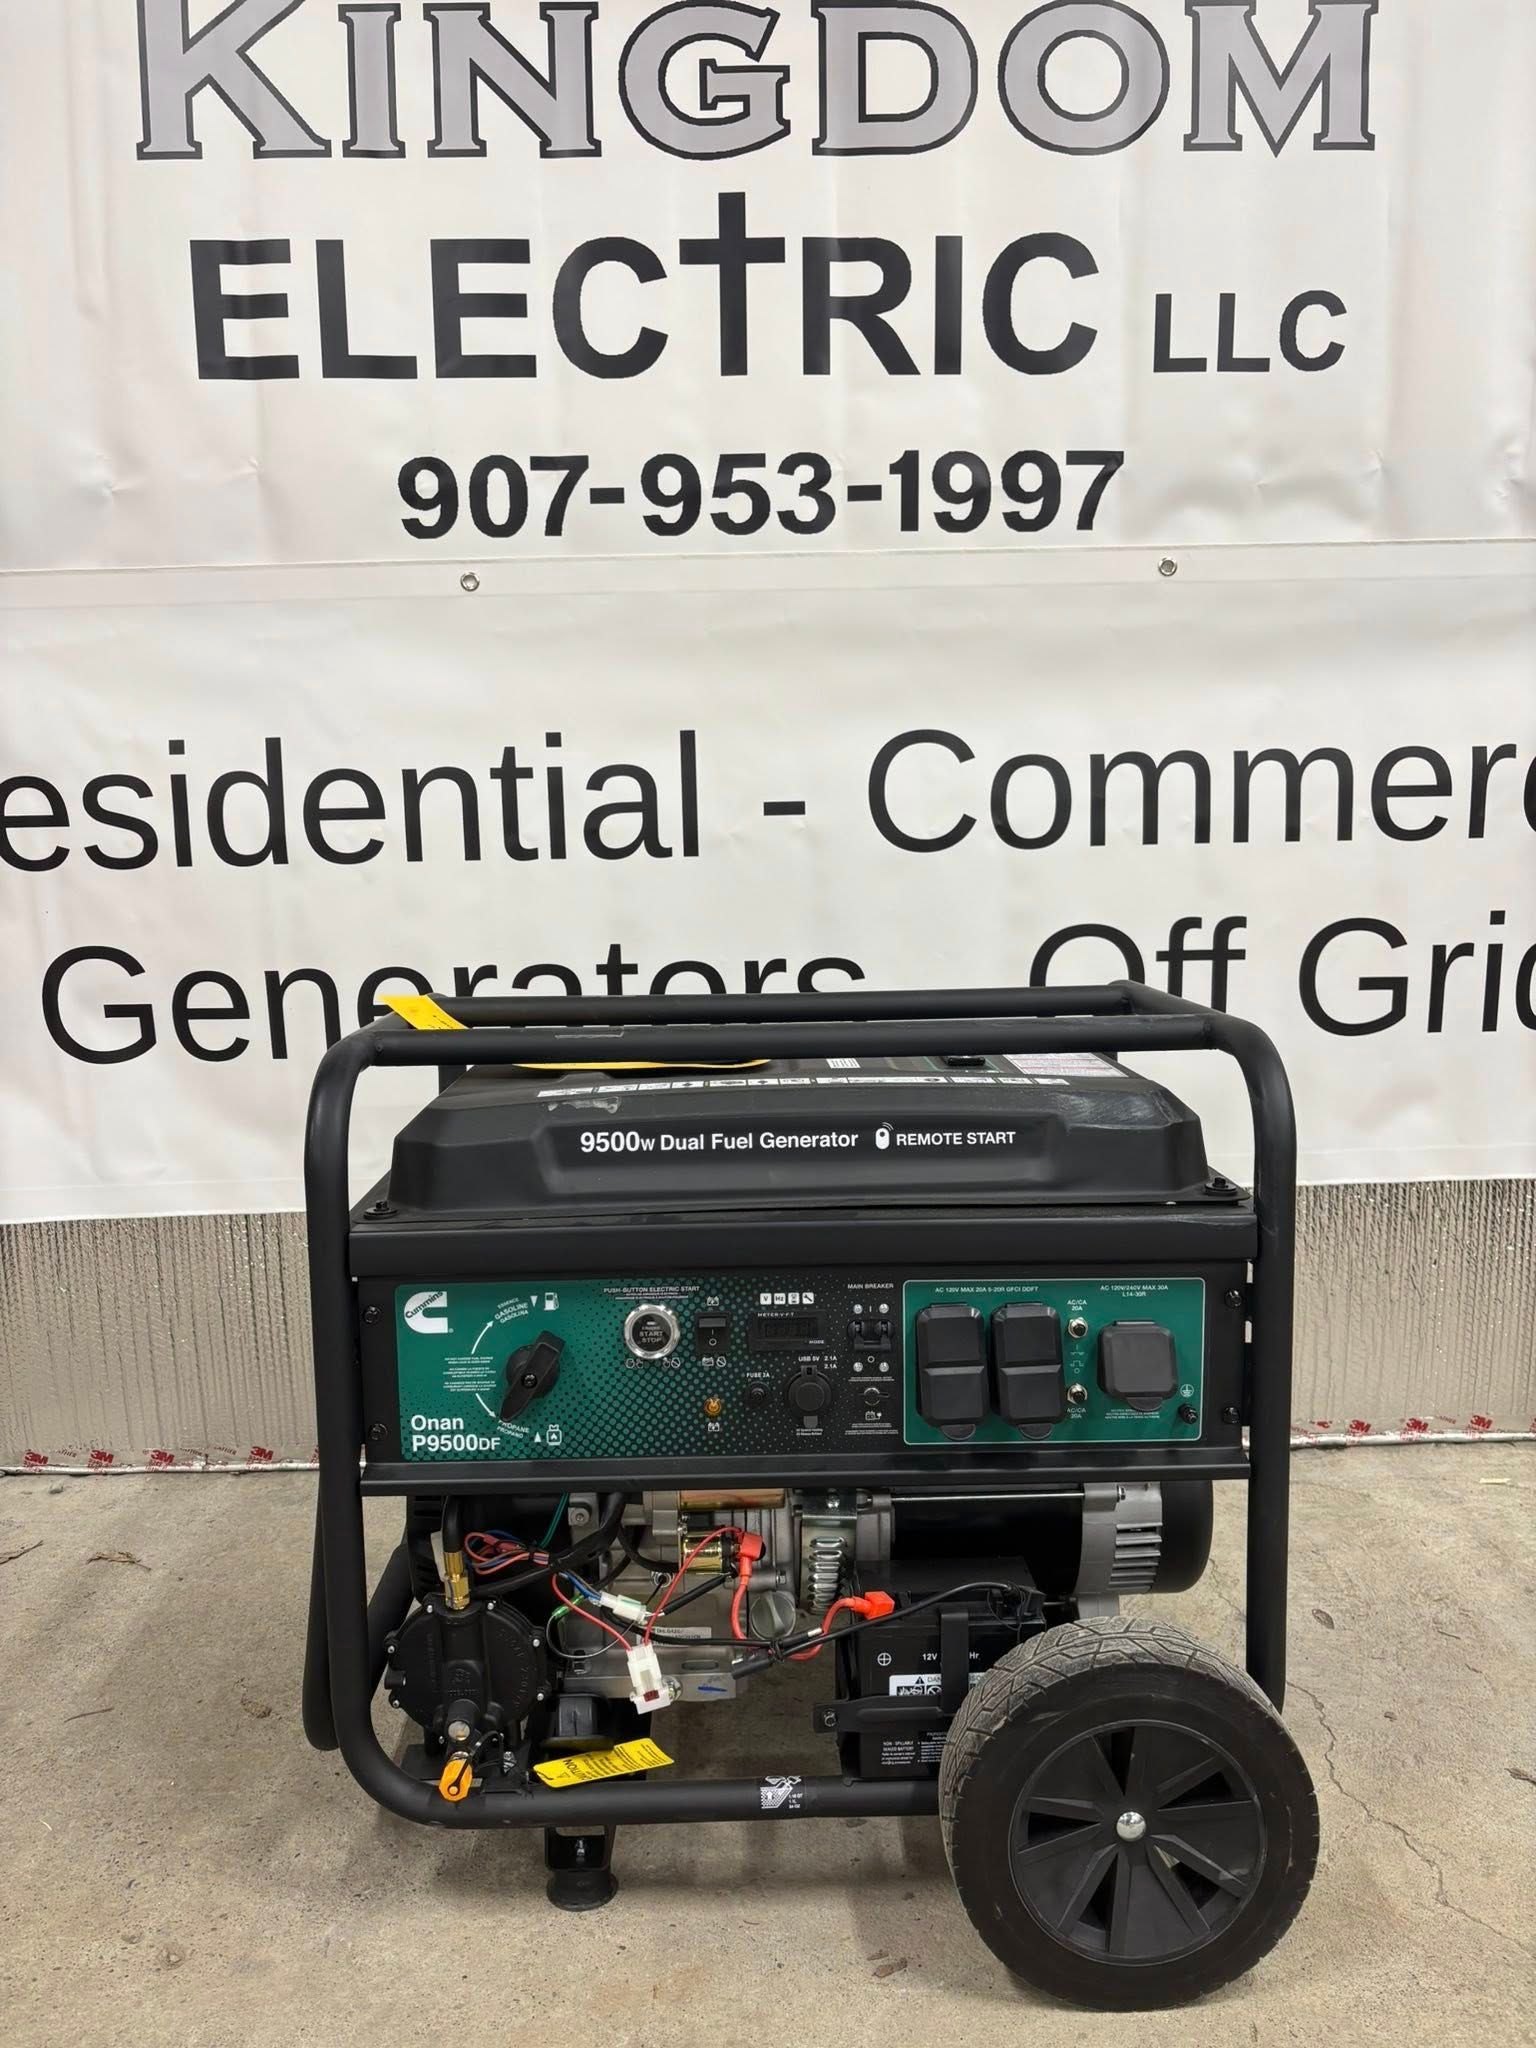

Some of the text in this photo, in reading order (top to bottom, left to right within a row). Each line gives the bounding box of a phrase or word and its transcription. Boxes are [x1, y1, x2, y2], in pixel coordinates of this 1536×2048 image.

[136, 0, 1378, 160] KINGDOM
[190, 192, 1347, 380] ELECTRIC LLC
[397, 450, 1125, 540] 907-953-1997
[868, 728, 1536, 854] Commer
[1029, 915, 1248, 1014] Off
[1298, 909, 1536, 1038] Gri
[660, 1134, 705, 1150] Dual
[711, 1133, 753, 1150] Fuel
[759, 1132, 859, 1149] Generator
[896, 1132, 1016, 1146] REMOTE START
[405, 1291, 444, 1319] Cummins
[494, 1302, 528, 1320] GASOLINE
[500, 1309, 528, 1324] GASOLINA
[410, 1414, 464, 1430] Onan
[498, 1420, 530, 1434] PROPANE
[412, 1434, 500, 1452] P9500DF
[250, 1446, 274, 1460] 3M
